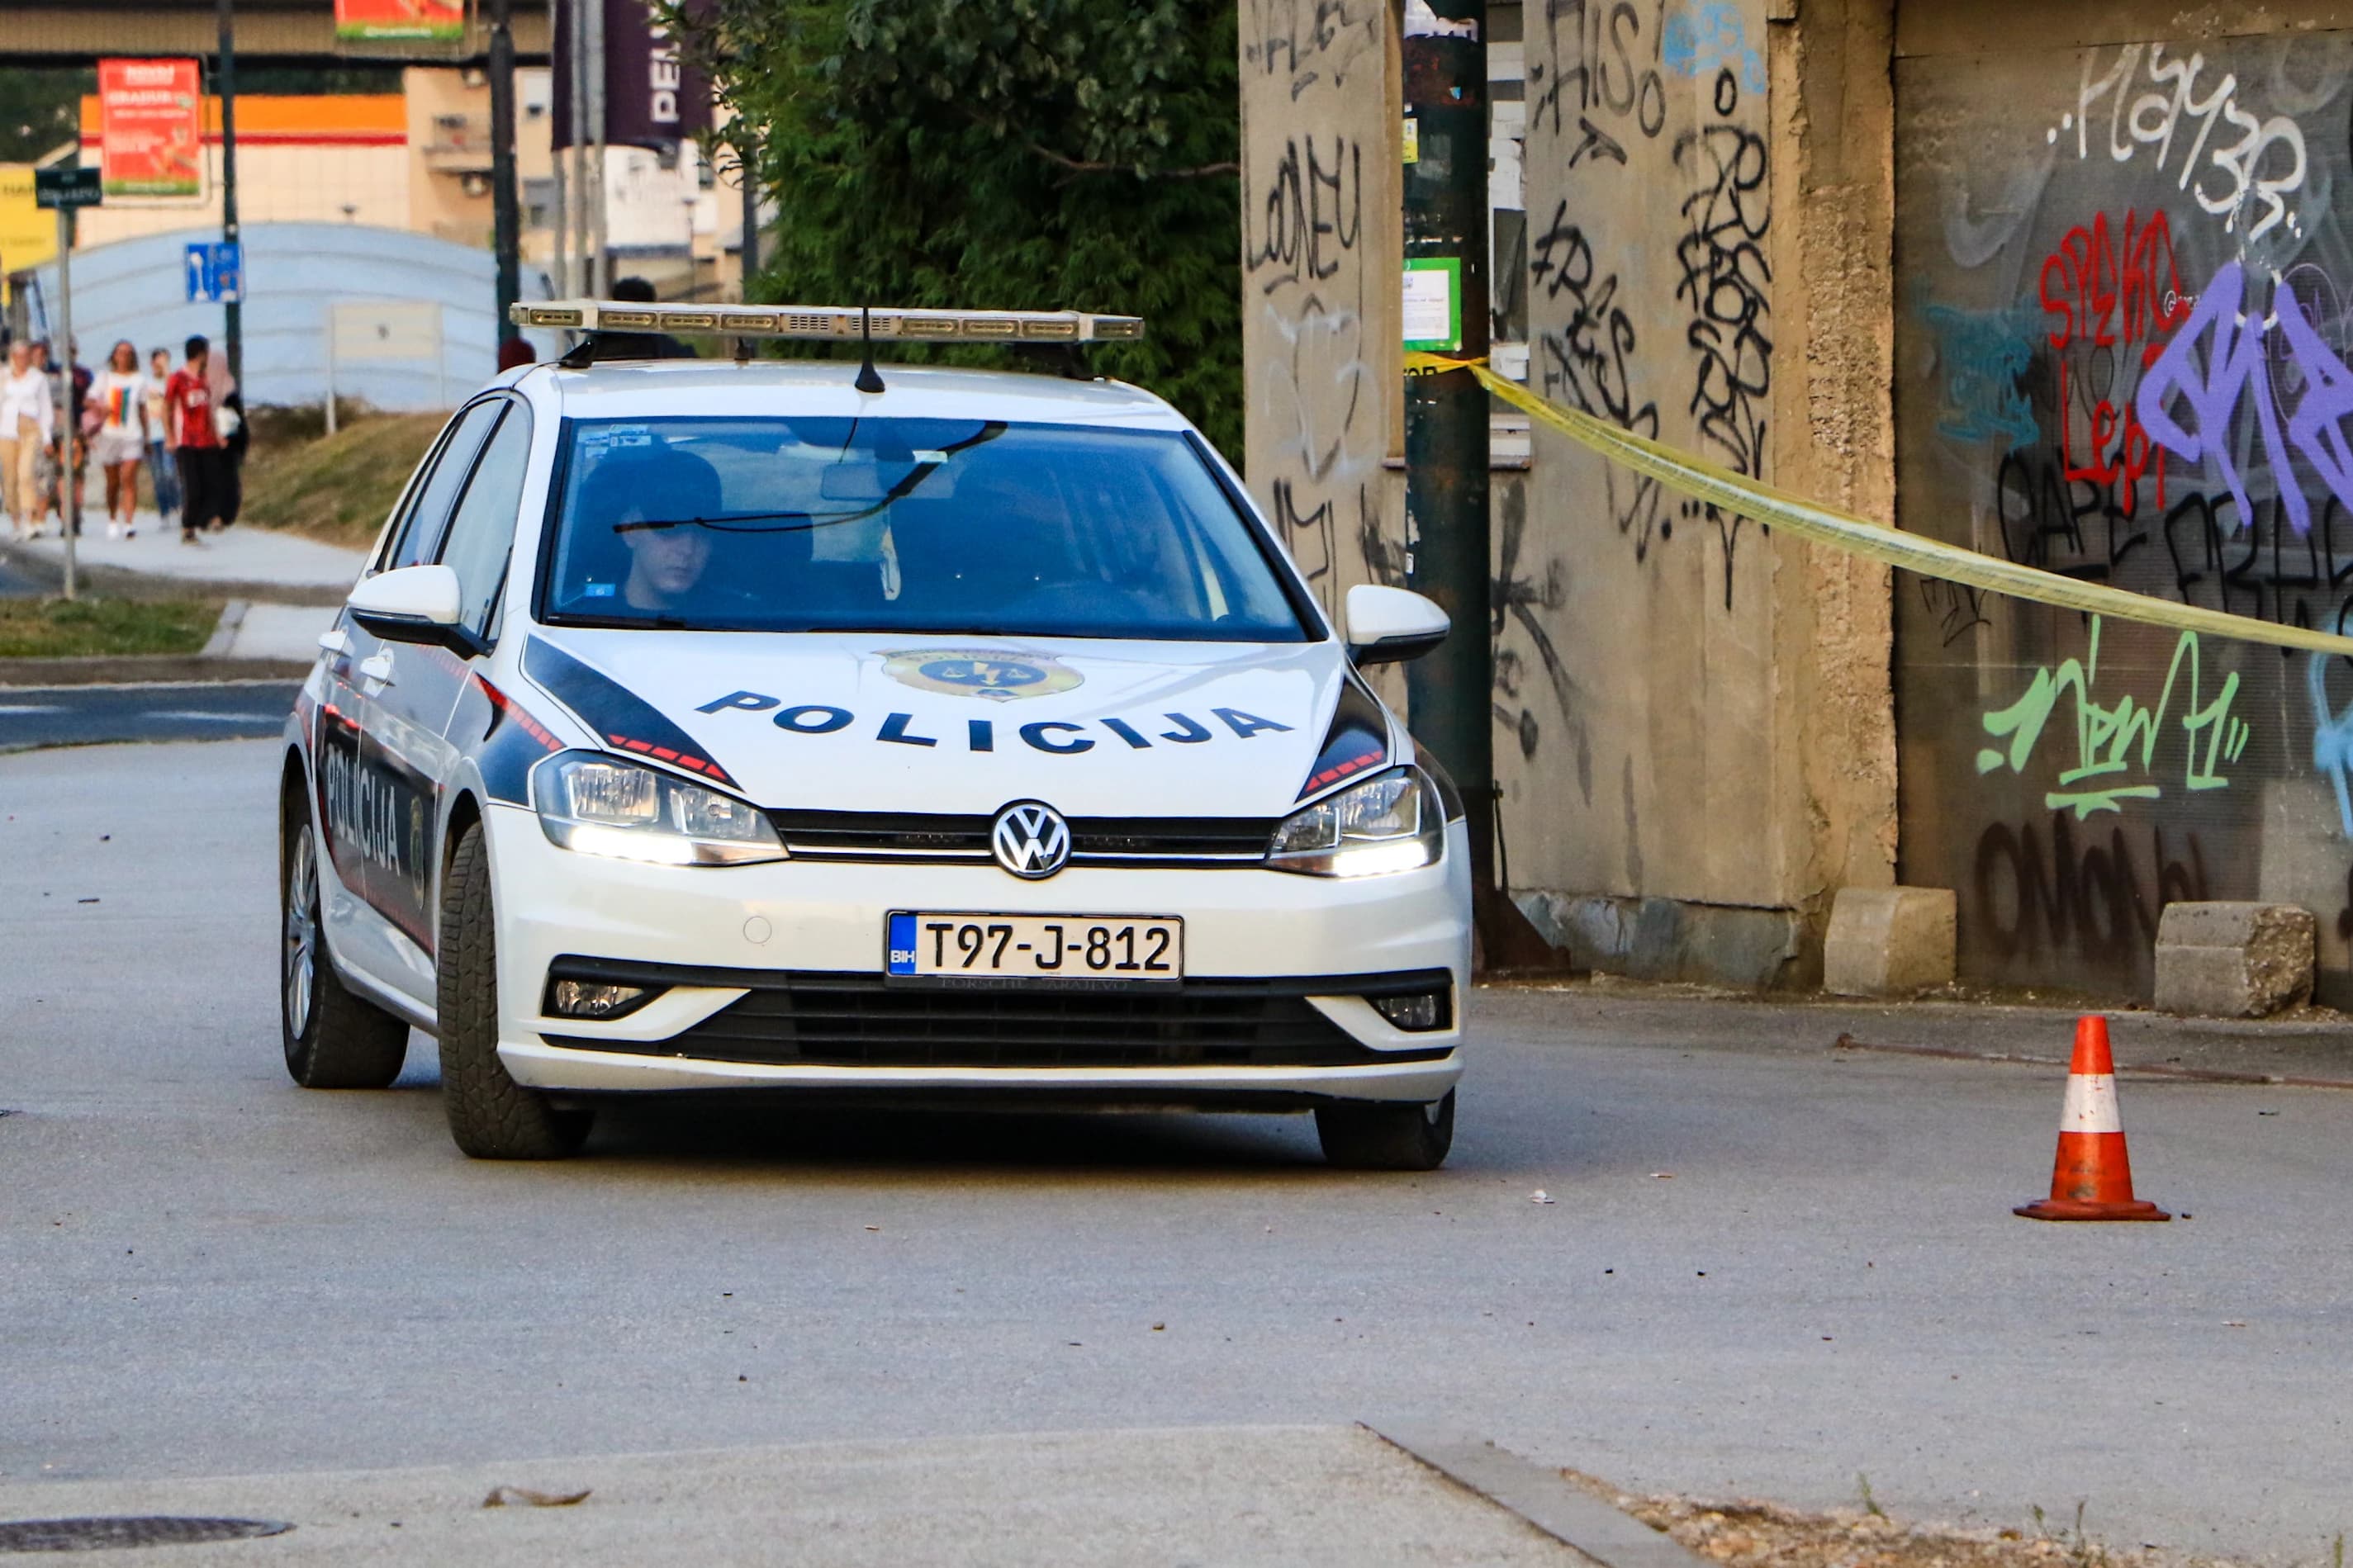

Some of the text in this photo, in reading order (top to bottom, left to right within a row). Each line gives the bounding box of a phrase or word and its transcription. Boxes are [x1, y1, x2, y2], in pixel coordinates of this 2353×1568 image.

[695, 689, 1295, 755] POLICIJA
[327, 741, 401, 878] POLICIJA
[995, 804, 1070, 874] VW
[890, 950, 915, 964] BIH
[926, 922, 1171, 971] T97-J-812
